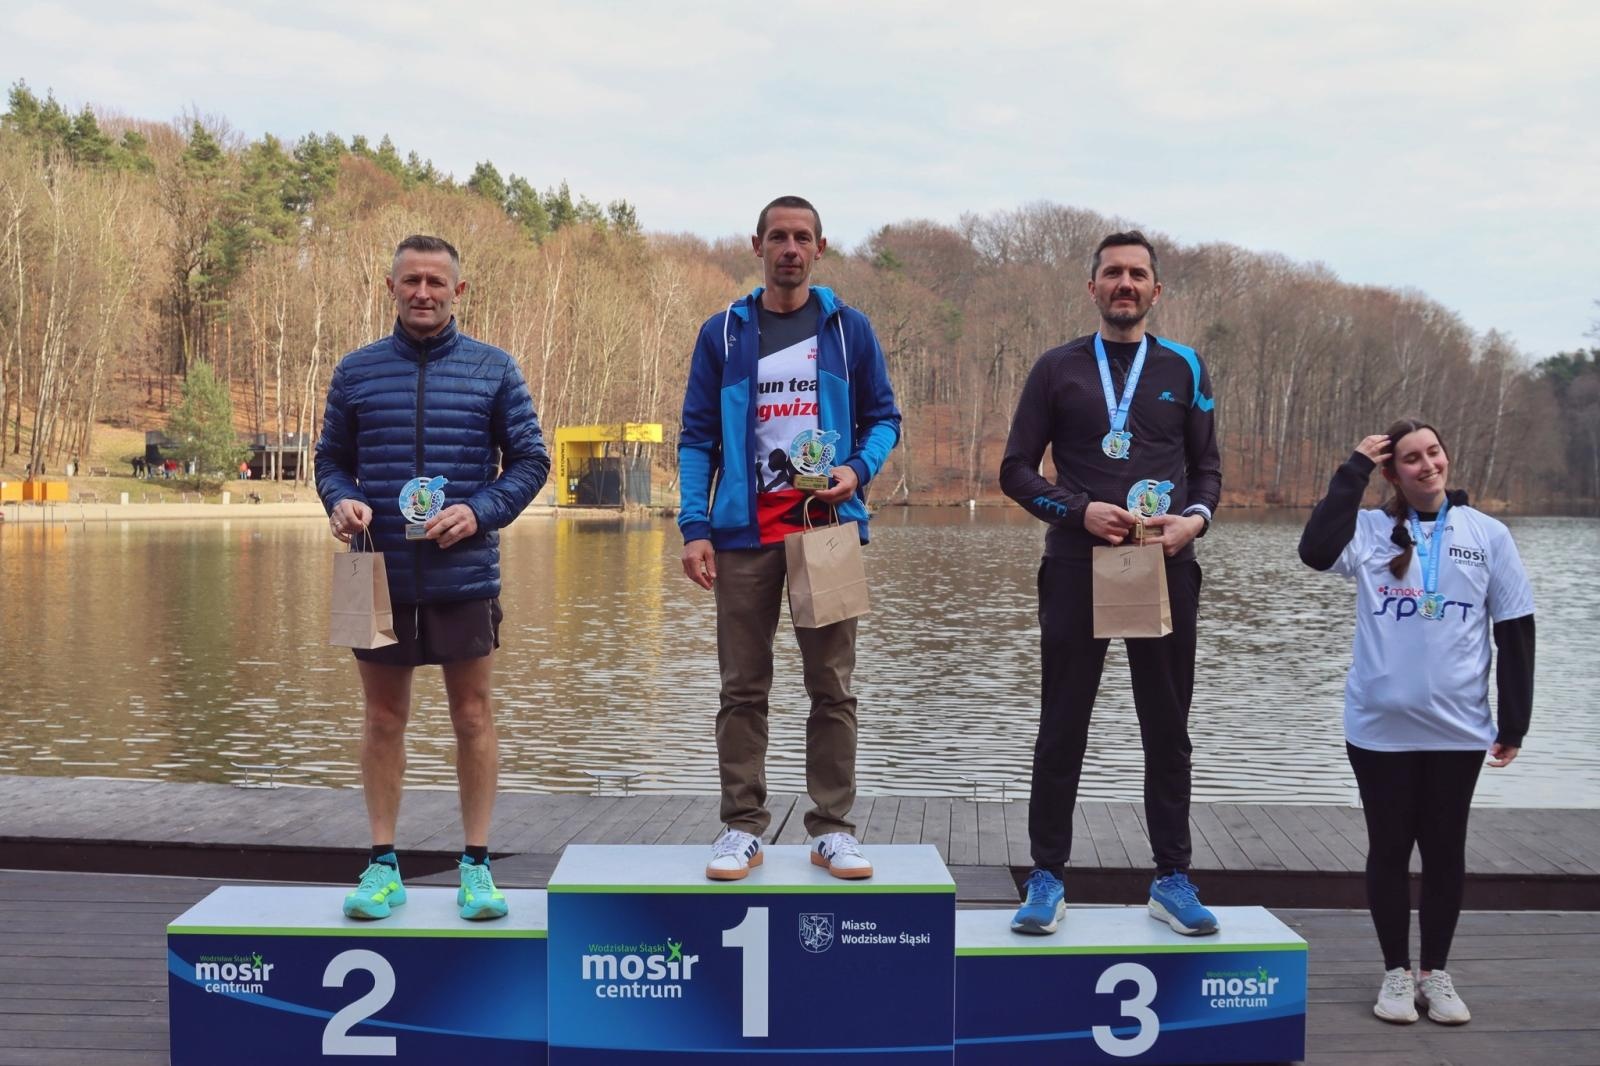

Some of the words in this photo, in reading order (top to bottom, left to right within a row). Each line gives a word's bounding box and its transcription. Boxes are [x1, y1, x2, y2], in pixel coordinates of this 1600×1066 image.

[757, 381, 784, 394] un
[755, 397, 819, 422] gwiz
[841, 920, 877, 930] Miasto
[841, 933, 897, 944] Wodzisław
[899, 931, 930, 946] Śląski
[588, 943, 637, 953] Wodzisław
[639, 943, 665, 954] Śląski
[195, 962, 274, 981] mosir
[582, 953, 699, 980] mosir
[722, 907, 769, 1037] 1
[205, 982, 263, 994] centrum
[595, 982, 682, 998] centrum
[1201, 977, 1279, 996] mosir
[322, 949, 397, 1056] 2
[1092, 962, 1160, 1057] 3
[1210, 997, 1268, 1008] centrum
